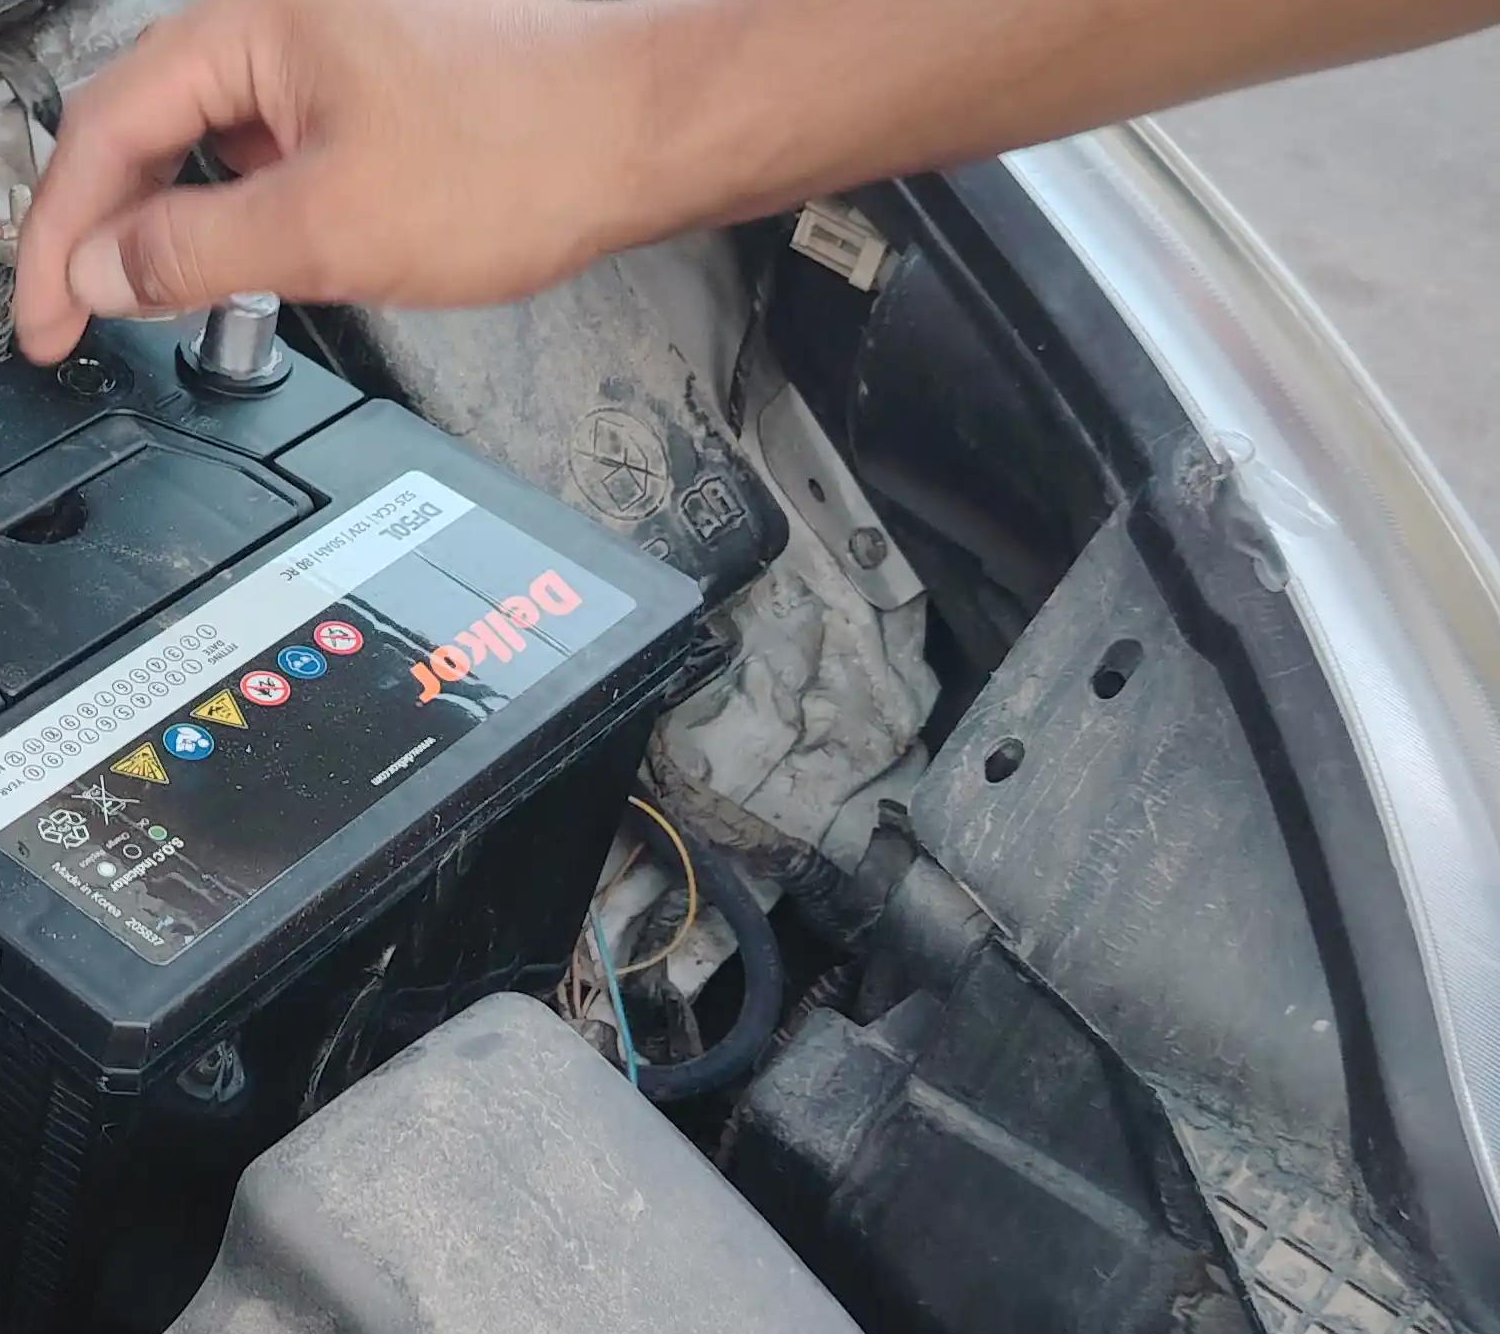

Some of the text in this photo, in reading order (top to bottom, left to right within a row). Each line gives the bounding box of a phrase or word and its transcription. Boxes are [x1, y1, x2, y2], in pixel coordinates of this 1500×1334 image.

[372, 503, 397, 519] CCA
[378, 501, 443, 541] DF50L
[349, 521, 370, 538] 12V
[315, 536, 346, 557] 50Ah
[410, 569, 583, 703] Delkor
[202, 640, 225, 656] DATE
[207, 643, 239, 665] FITTING
[110, 857, 157, 892] Indicator
[51, 862, 81, 887] Made
[80, 883, 92, 895] in
[91, 892, 122, 918] Korea
